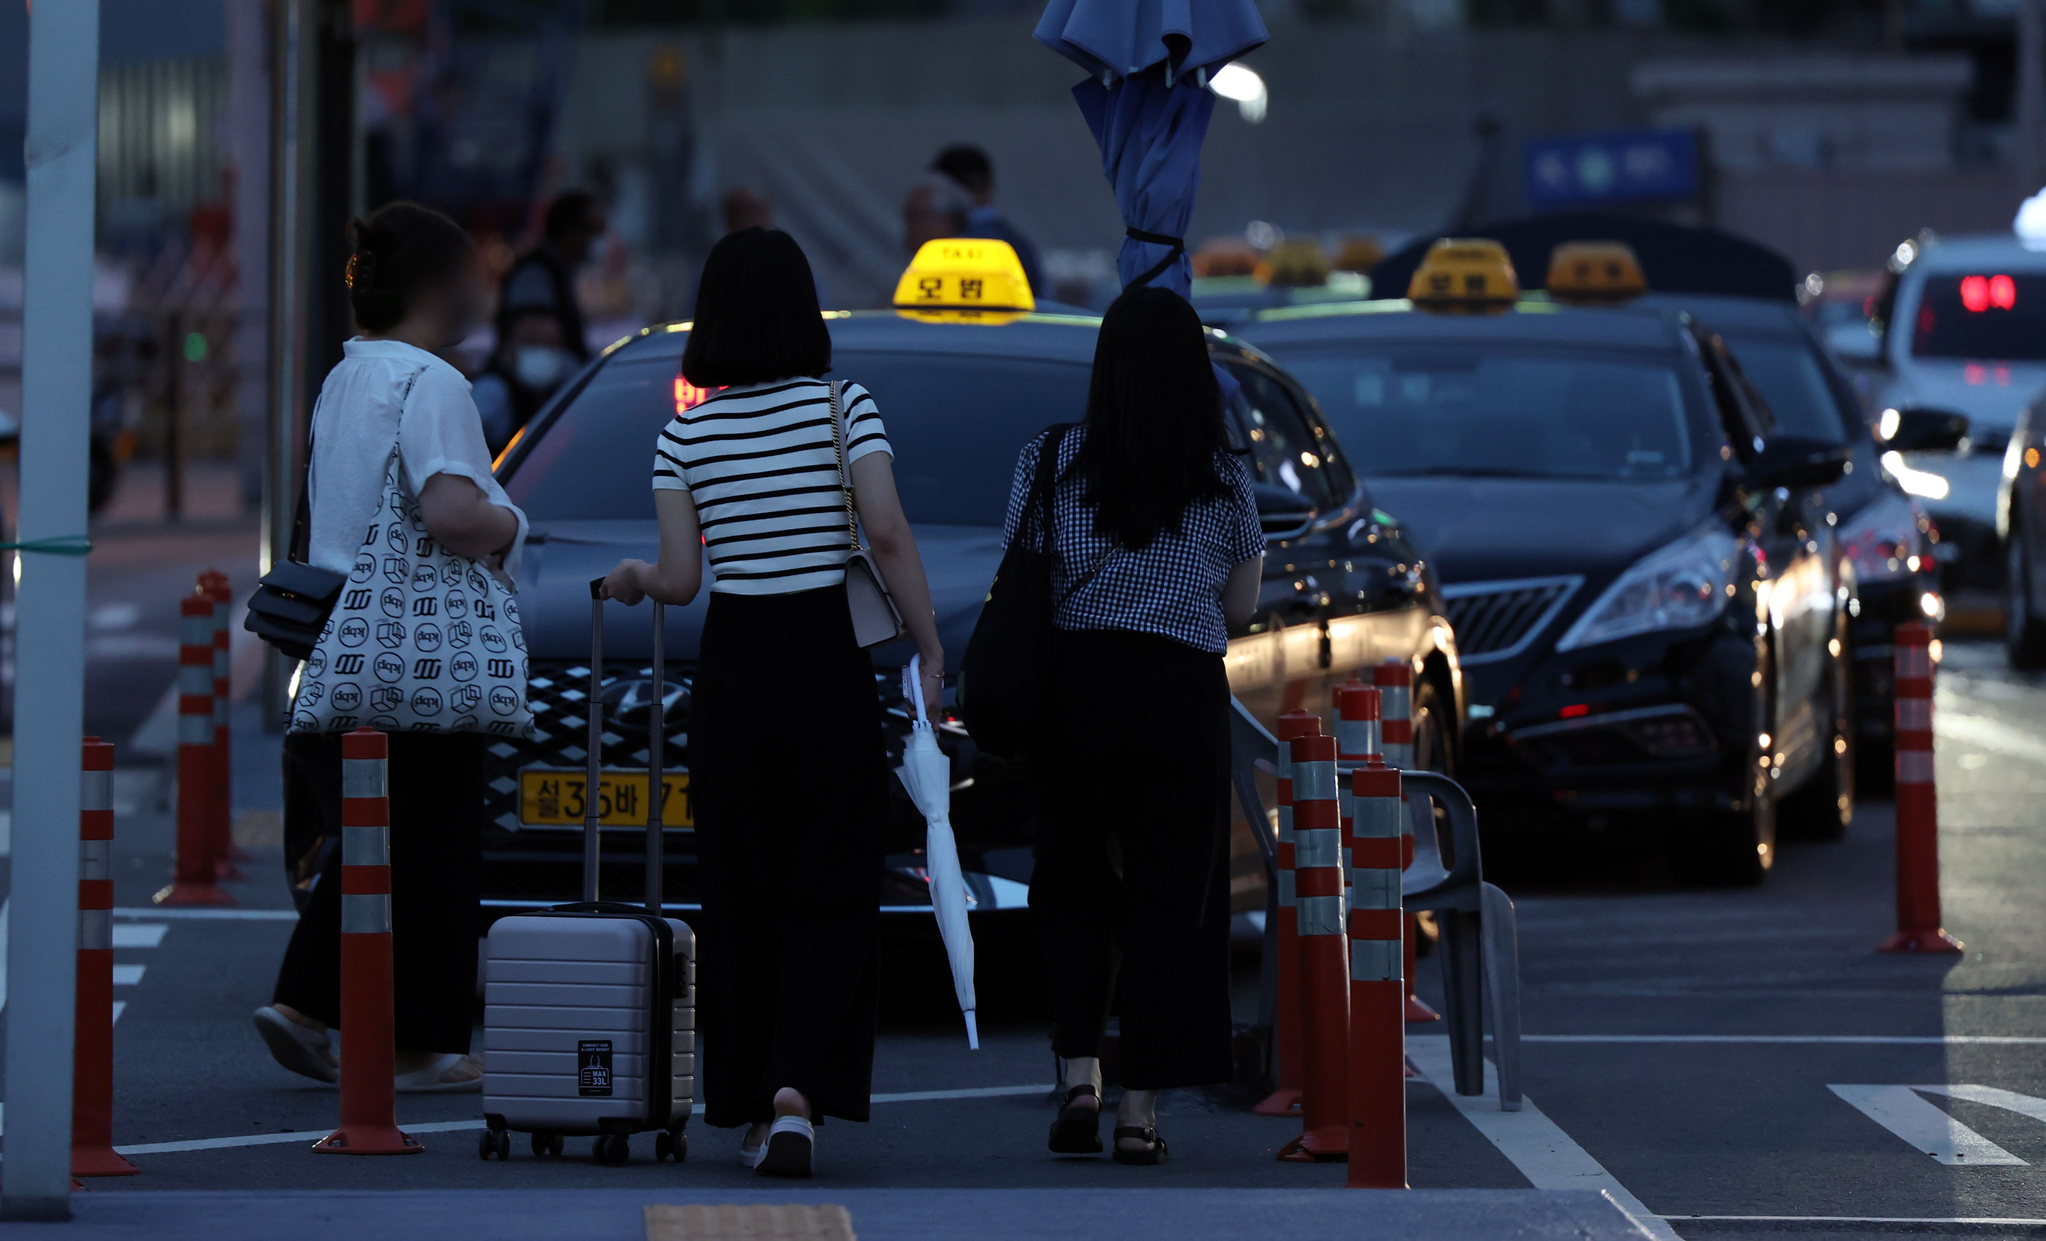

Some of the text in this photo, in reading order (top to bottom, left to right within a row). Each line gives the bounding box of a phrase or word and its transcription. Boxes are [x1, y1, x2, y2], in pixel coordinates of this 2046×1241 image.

[943, 247, 983, 259] TAXI
[918, 277, 983, 299] 모범
[342, 625, 366, 638] kbp
[417, 630, 439, 643] kbp
[377, 659, 402, 674] kbp
[453, 660, 476, 672] kbp
[334, 690, 359, 703] kbp
[414, 695, 439, 708] kbp
[492, 693, 516, 707] kbp
[592, 1077, 607, 1085] 33L
